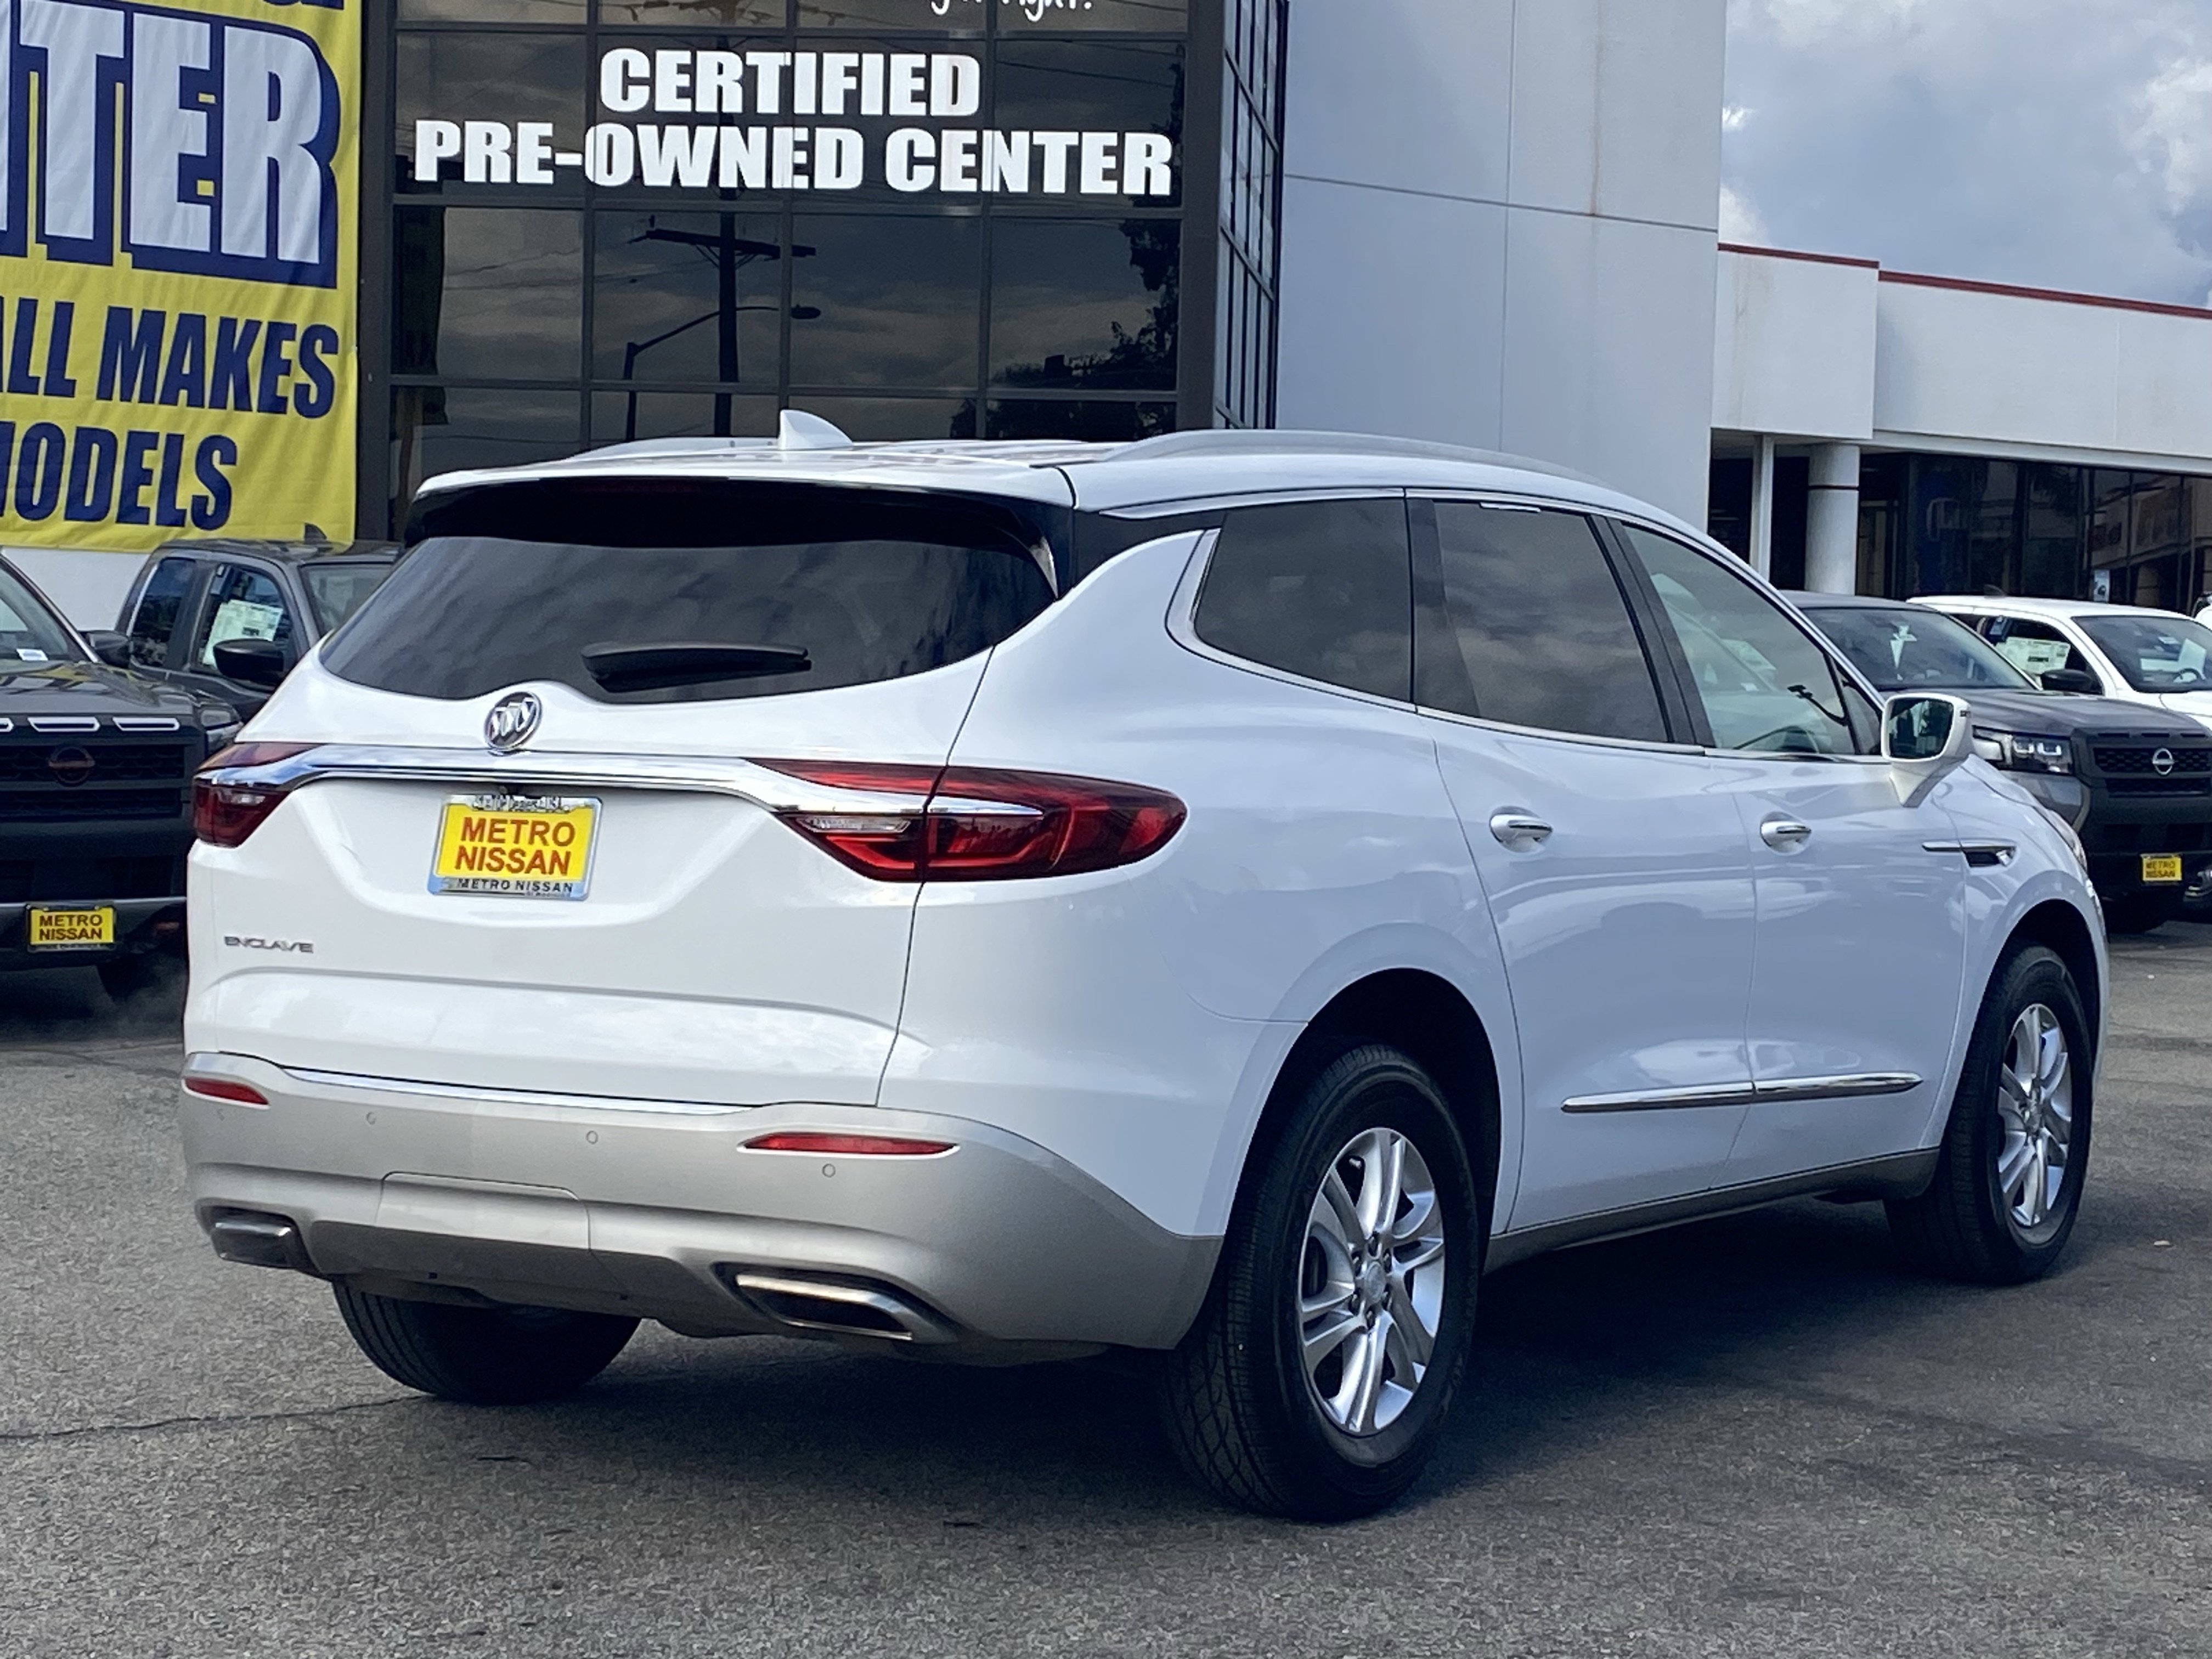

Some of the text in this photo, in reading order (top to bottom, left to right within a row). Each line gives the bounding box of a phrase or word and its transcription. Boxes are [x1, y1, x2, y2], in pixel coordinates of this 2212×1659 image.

[600, 48, 980, 116] CERTIFIED
[0, 0, 336, 281] TER
[414, 120, 1172, 196] PRE-OWNED CENTER
[0, 296, 339, 419] LL MAKES
[0, 421, 238, 532] ODELS
[460, 816, 575, 847] METRO
[454, 845, 572, 876] NISSAN
[458, 878, 573, 893] METRO NISSAN
[39, 915, 103, 927] METRO
[39, 928, 102, 941] NISSAN
[224, 936, 314, 954] ENCLAVE
